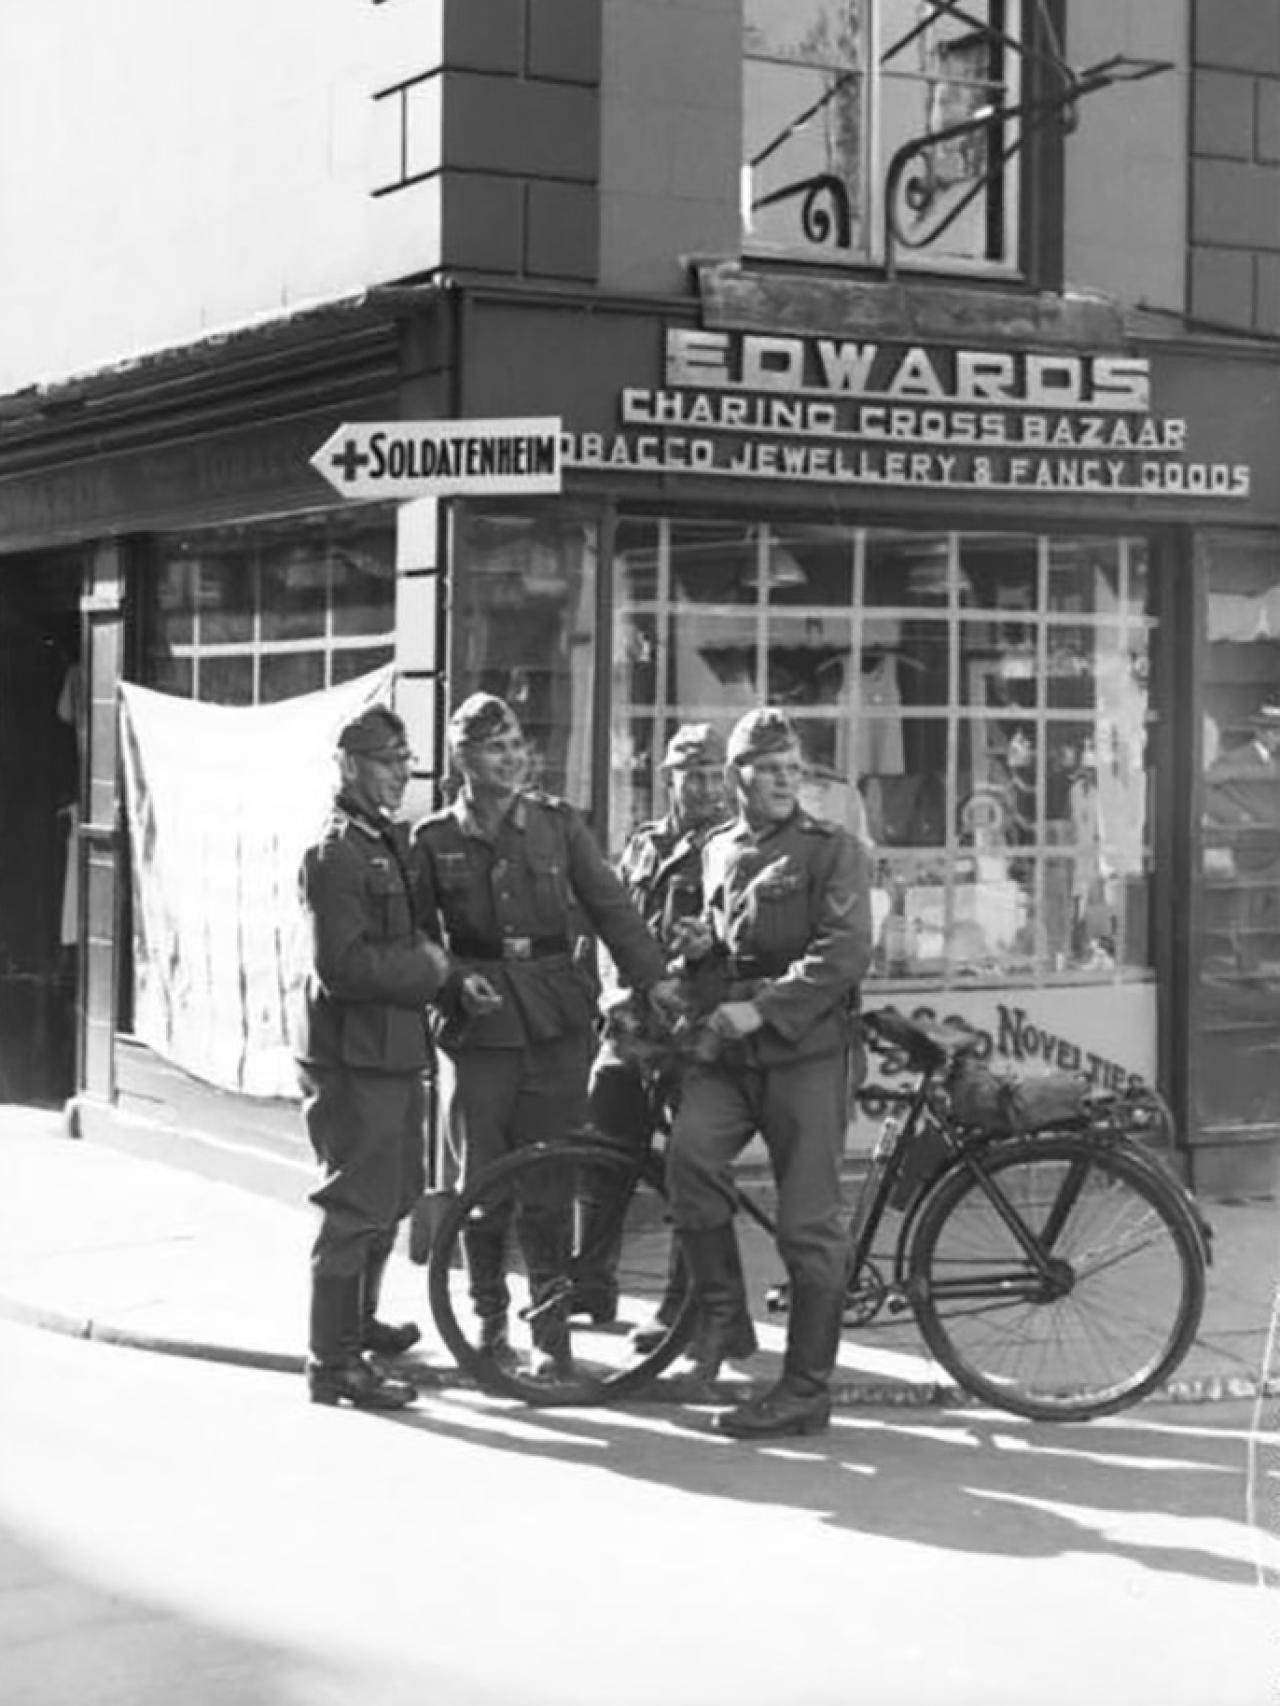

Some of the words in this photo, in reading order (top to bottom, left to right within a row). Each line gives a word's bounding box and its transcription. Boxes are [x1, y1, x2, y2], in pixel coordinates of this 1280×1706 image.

[667, 328, 1149, 410] EDWARDS
[623, 388, 836, 434] CHARING
[861, 406, 1005, 443] CROSS
[1023, 414, 1187, 450] BAZAAR
[368, 432, 555, 478] SOLDATENHEIM
[561, 432, 713, 470] OBACCO
[730, 441, 957, 486] JEWELLERY
[1010, 457, 1125, 490] FANCY
[1141, 461, 1250, 497] GOODS
